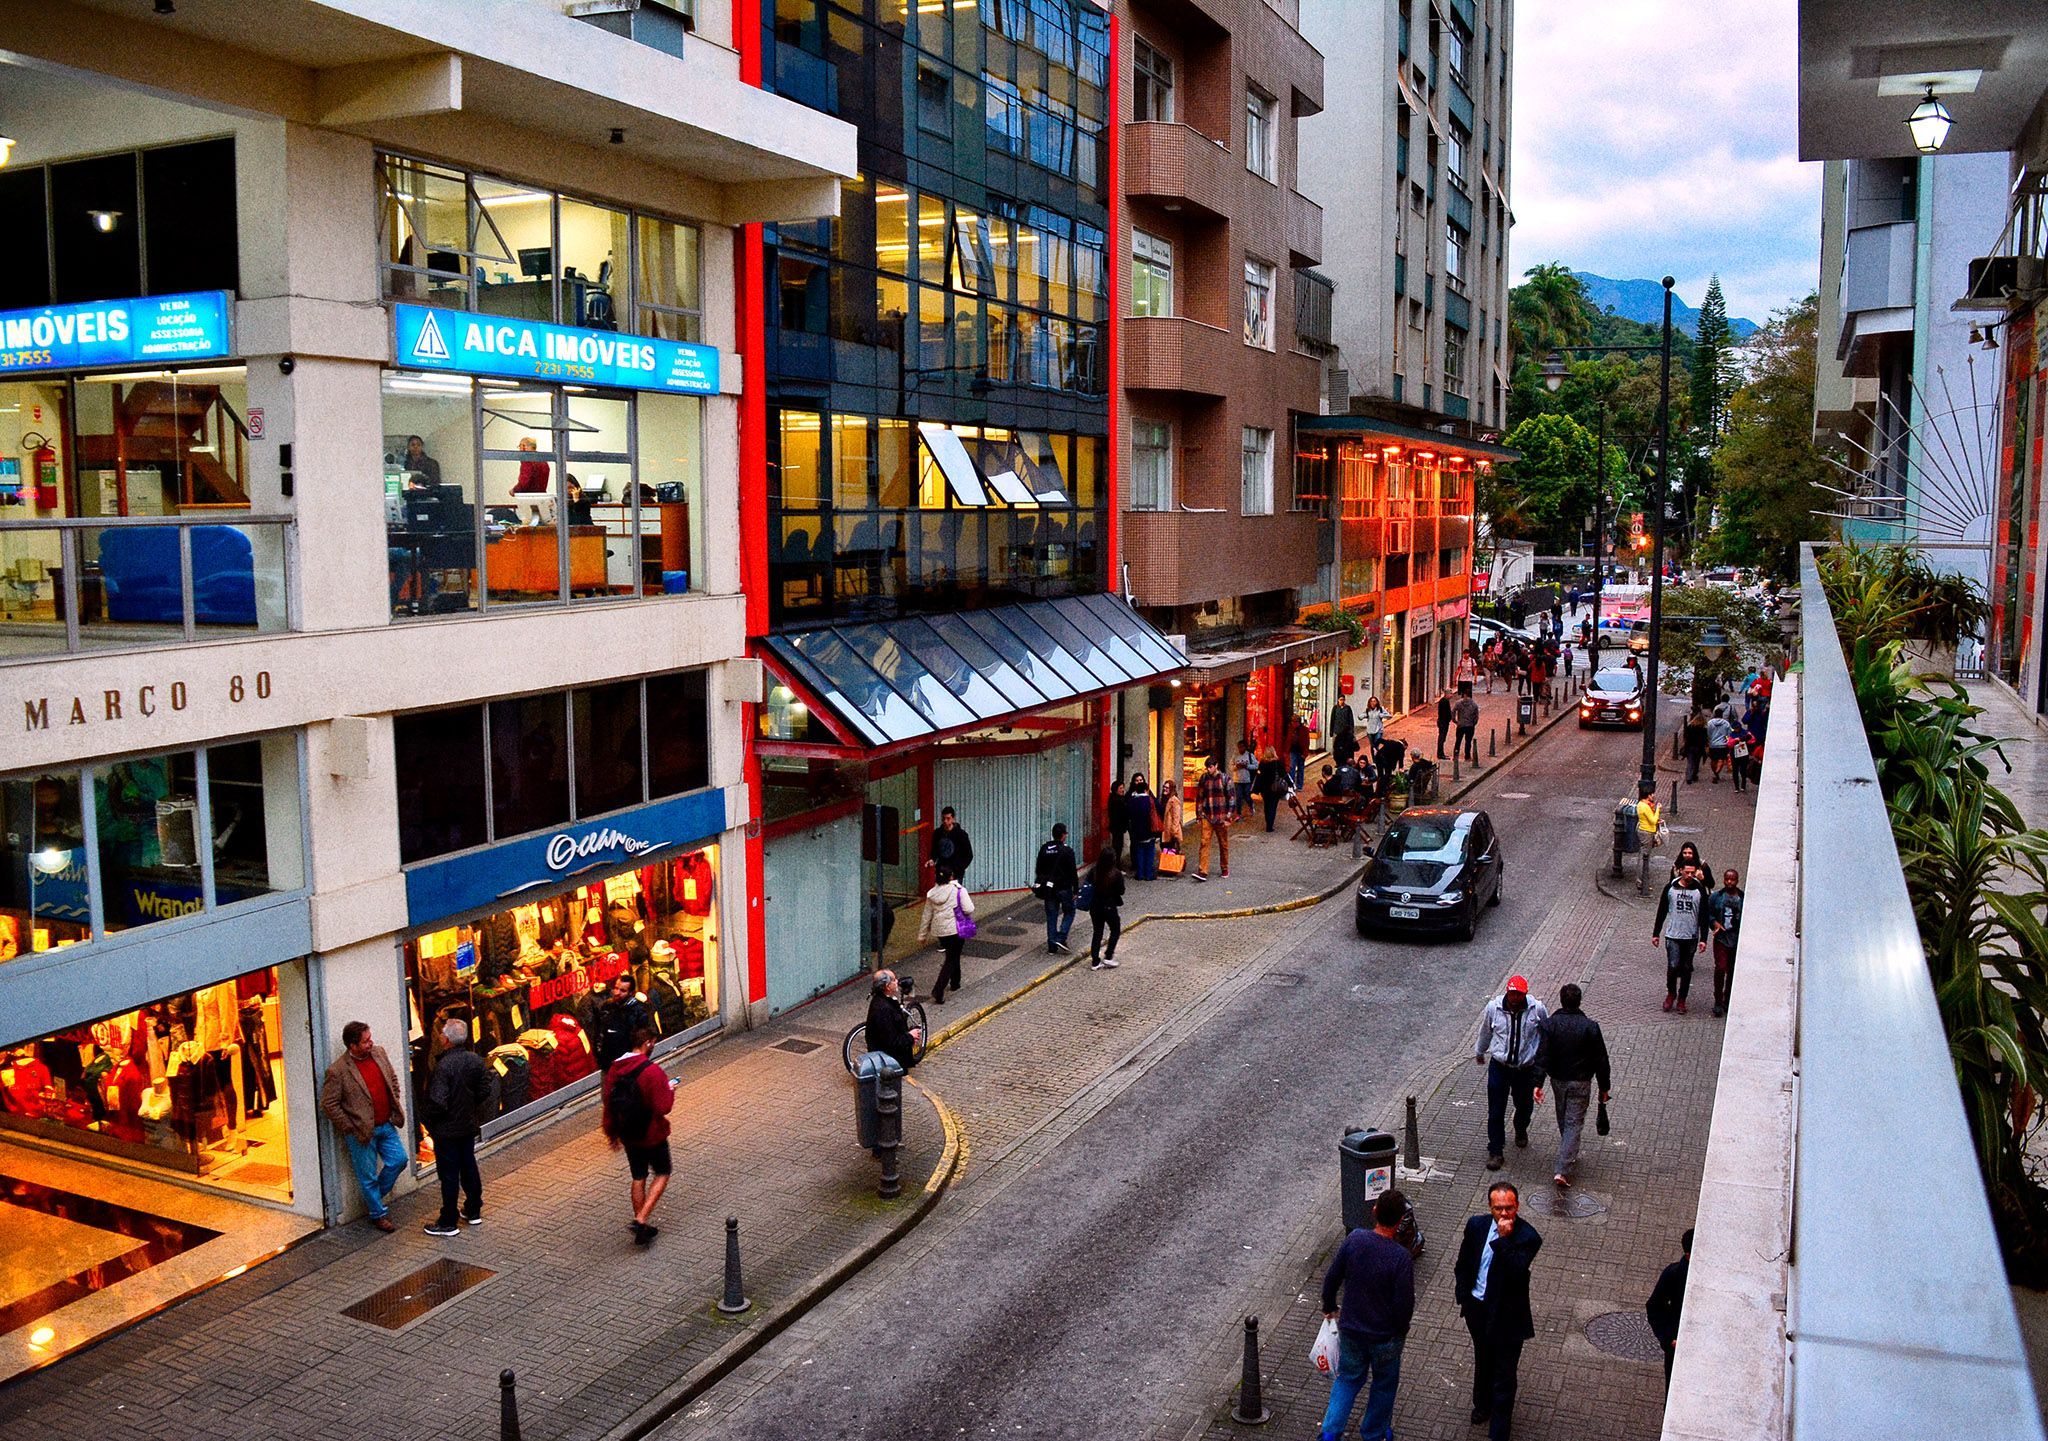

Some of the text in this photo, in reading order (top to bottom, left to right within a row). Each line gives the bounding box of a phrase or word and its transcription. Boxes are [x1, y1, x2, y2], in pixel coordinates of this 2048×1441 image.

[160, 300, 190, 311] VENDA
[156, 311, 197, 326] LOCAÇÃO
[151, 327, 204, 339] ASSESSORIA
[142, 338, 211, 354] ADMINISTRAÇÃO
[464, 323, 656, 371] AICA IMÓVEIS
[677, 348, 697, 357] VENDA
[674, 357, 701, 368] LOCAÇÃO
[24, 671, 271, 731] MARÇO 80
[1676, 900, 1693, 911] 99
